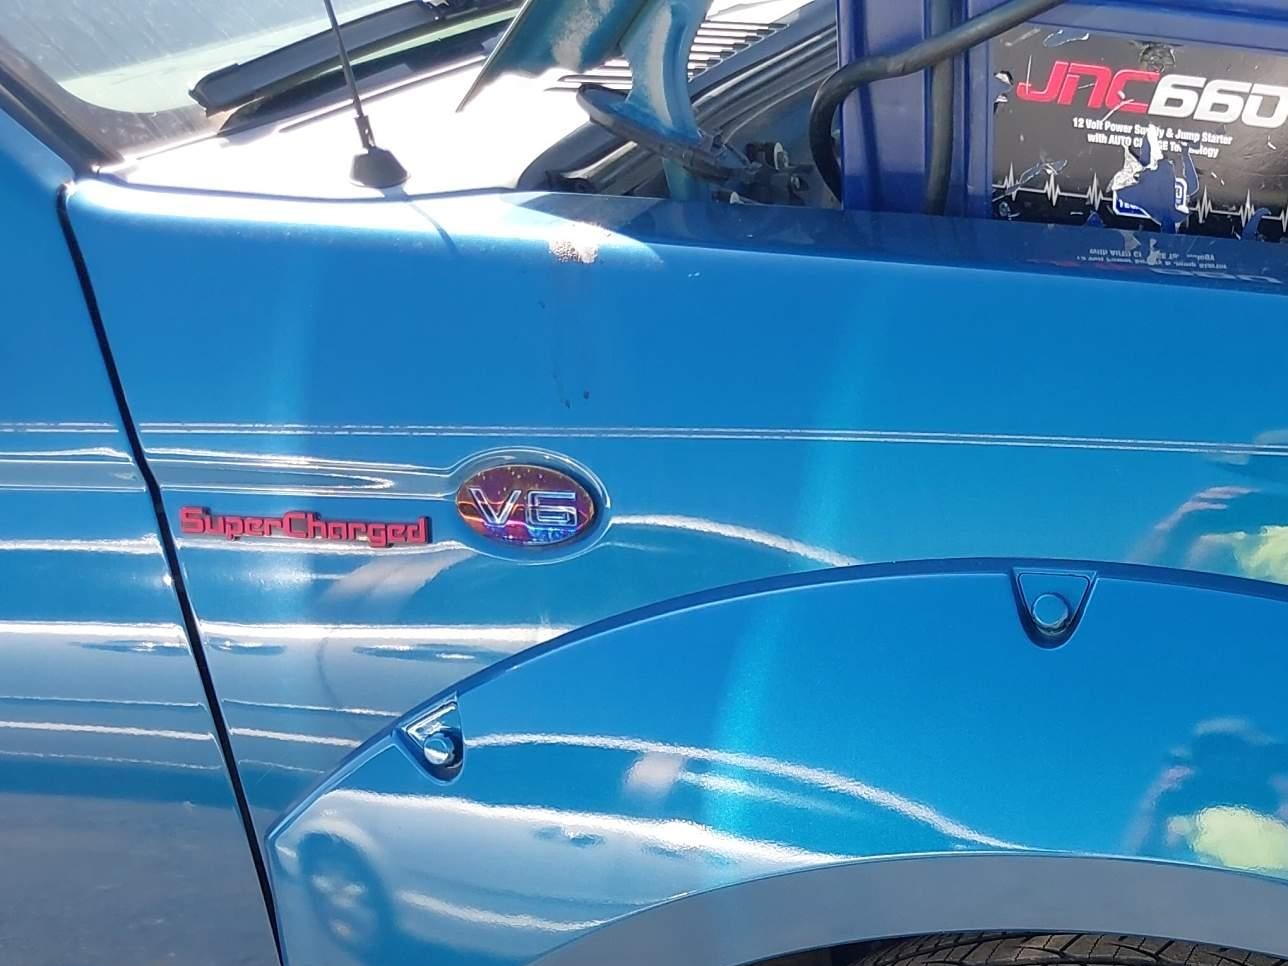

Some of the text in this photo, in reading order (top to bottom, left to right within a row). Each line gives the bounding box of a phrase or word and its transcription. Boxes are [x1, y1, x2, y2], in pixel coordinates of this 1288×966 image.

[1072, 117, 1085, 128] 12
[1085, 118, 1104, 131] Volt
[1104, 120, 1133, 134] Power
[1165, 127, 1174, 138] &
[1174, 128, 1201, 143] Jump
[1201, 131, 1233, 145] Starter
[1087, 133, 1108, 144] with
[1108, 135, 1132, 147] AUTO
[469, 487, 578, 527] V6
[179, 505, 431, 548] SuperCharged
